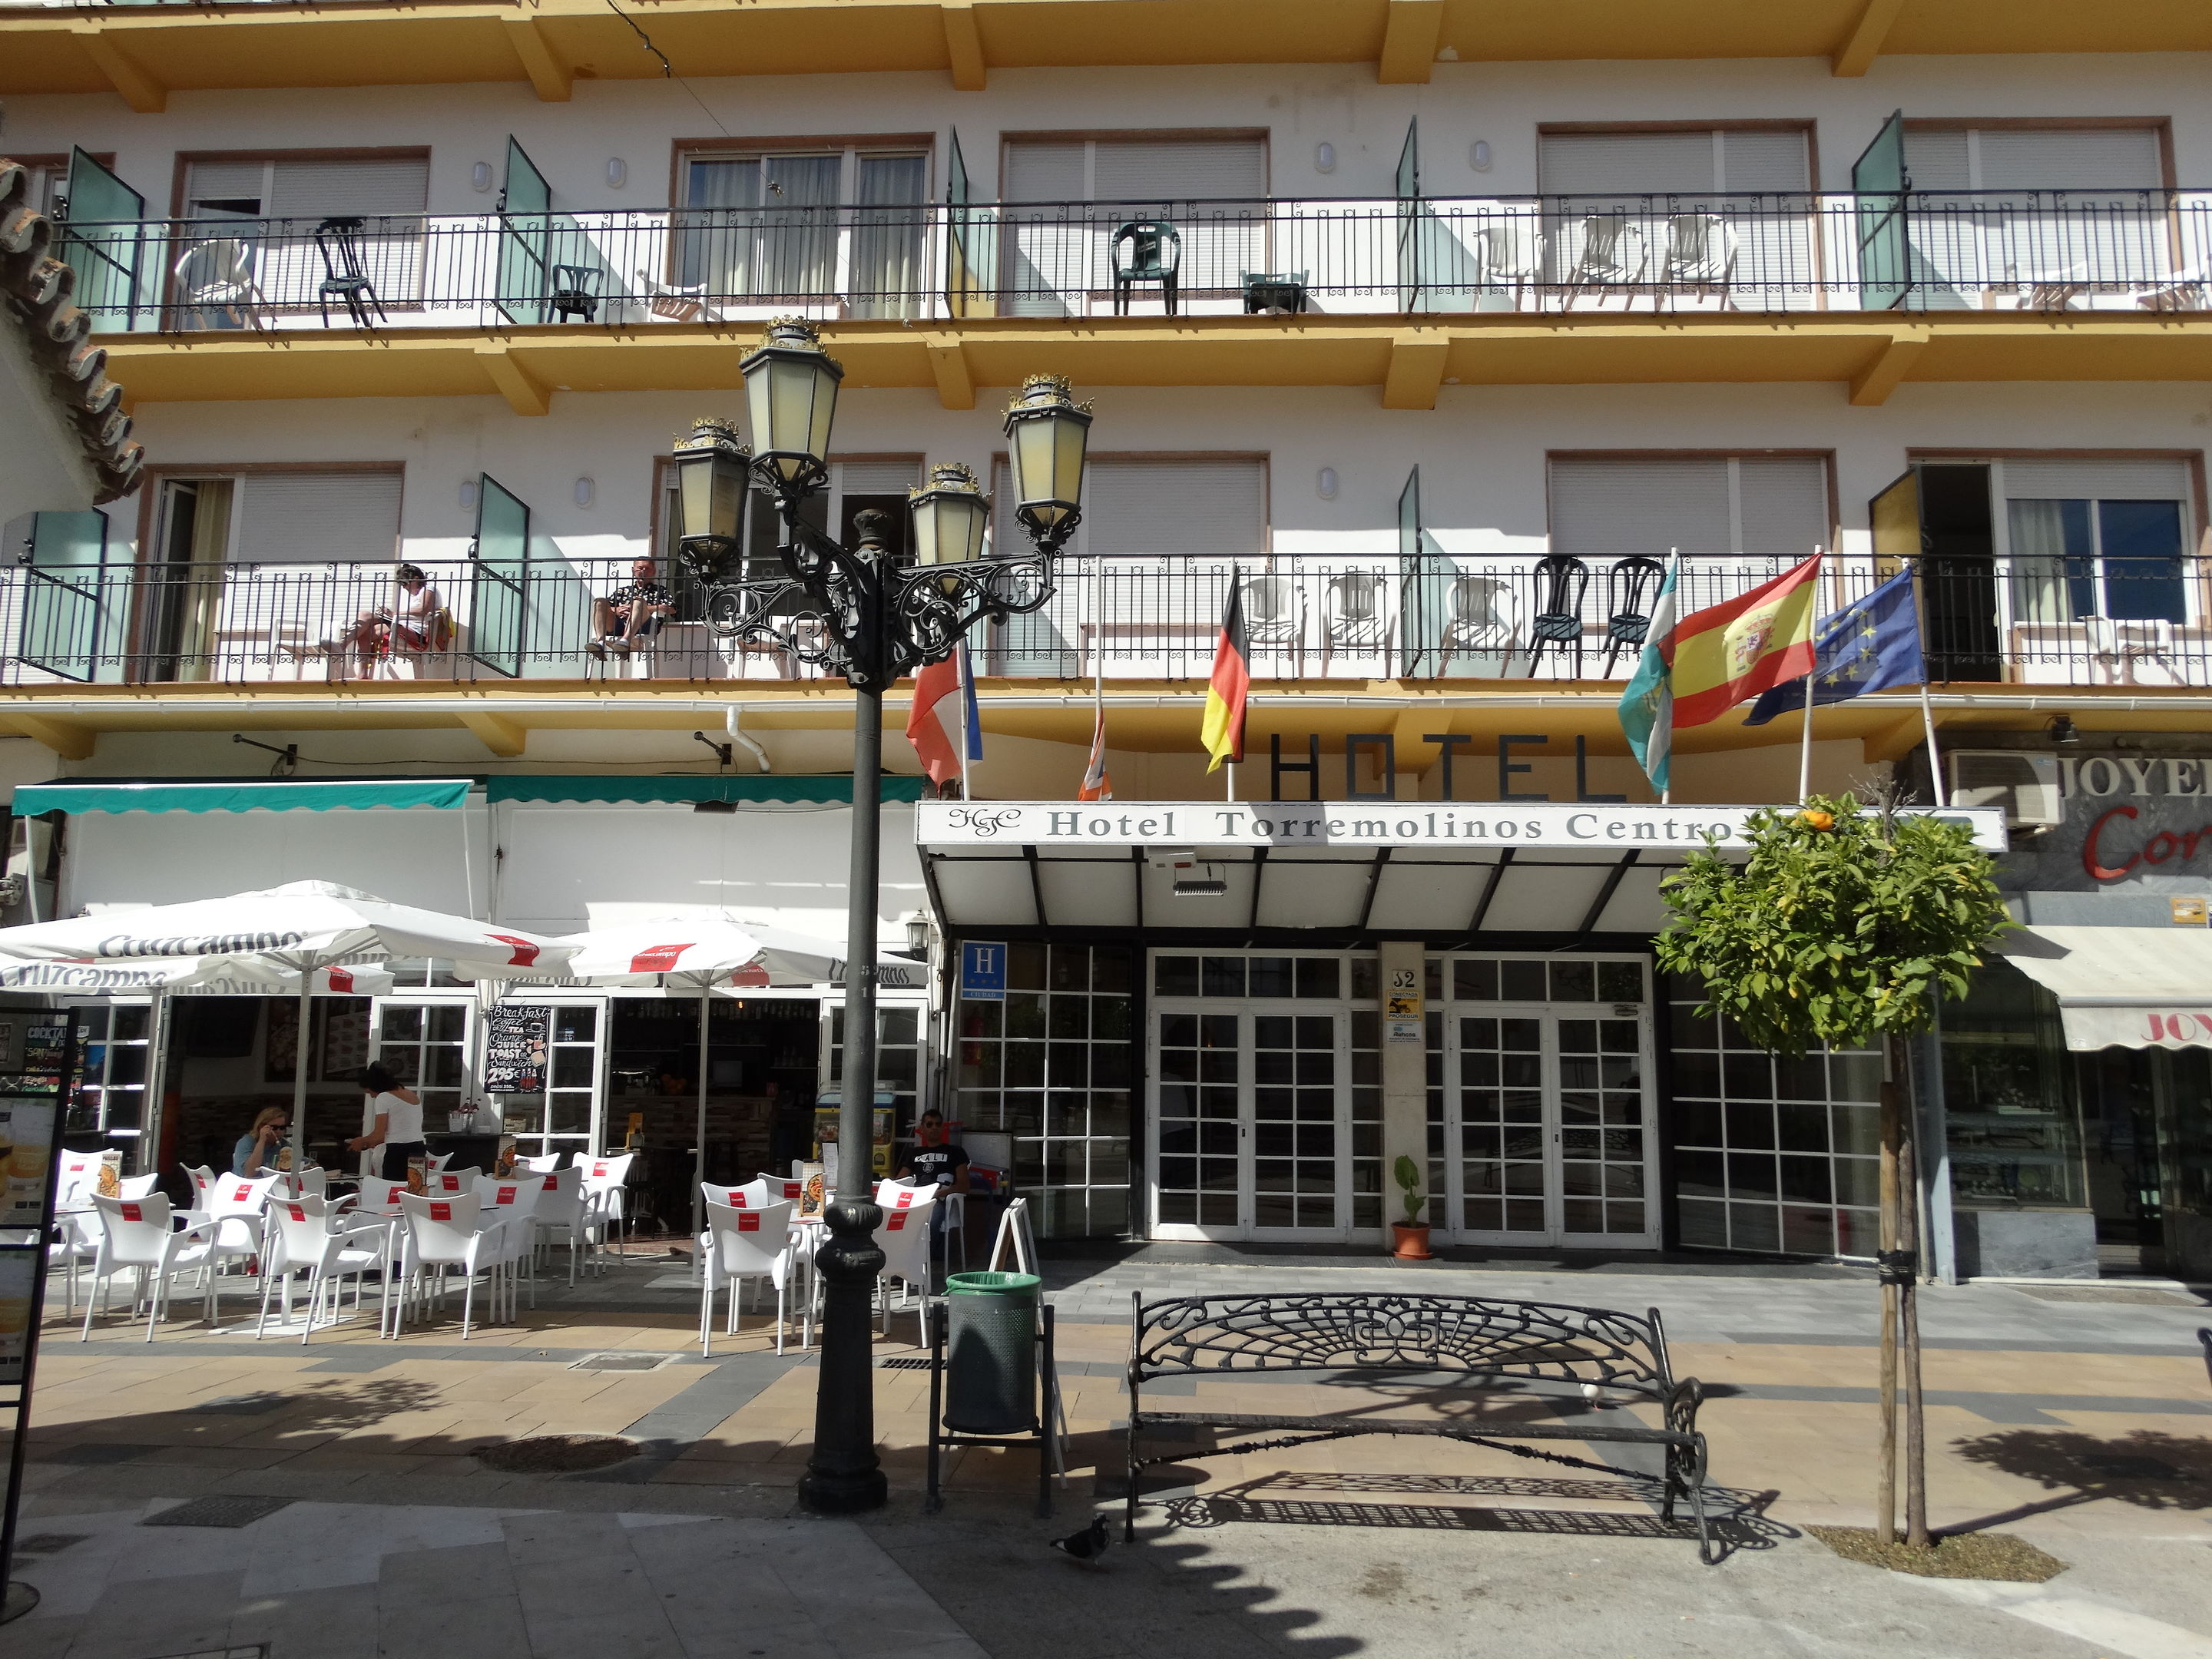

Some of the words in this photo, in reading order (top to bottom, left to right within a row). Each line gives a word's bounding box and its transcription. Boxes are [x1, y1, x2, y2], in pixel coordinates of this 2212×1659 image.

[1271, 733, 1627, 802] HOTEL
[1046, 811, 1177, 836] Hotel
[1215, 812, 1542, 839] Torremolinos
[1566, 813, 1732, 840] Centro
[974, 947, 995, 974] H
[493, 1005, 548, 1019] Breakfast
[492, 1018, 524, 1031] Coffee
[489, 1033, 524, 1047] Orange
[488, 1048, 522, 1060] TOAST
[488, 1056, 533, 1068] Sandwich
